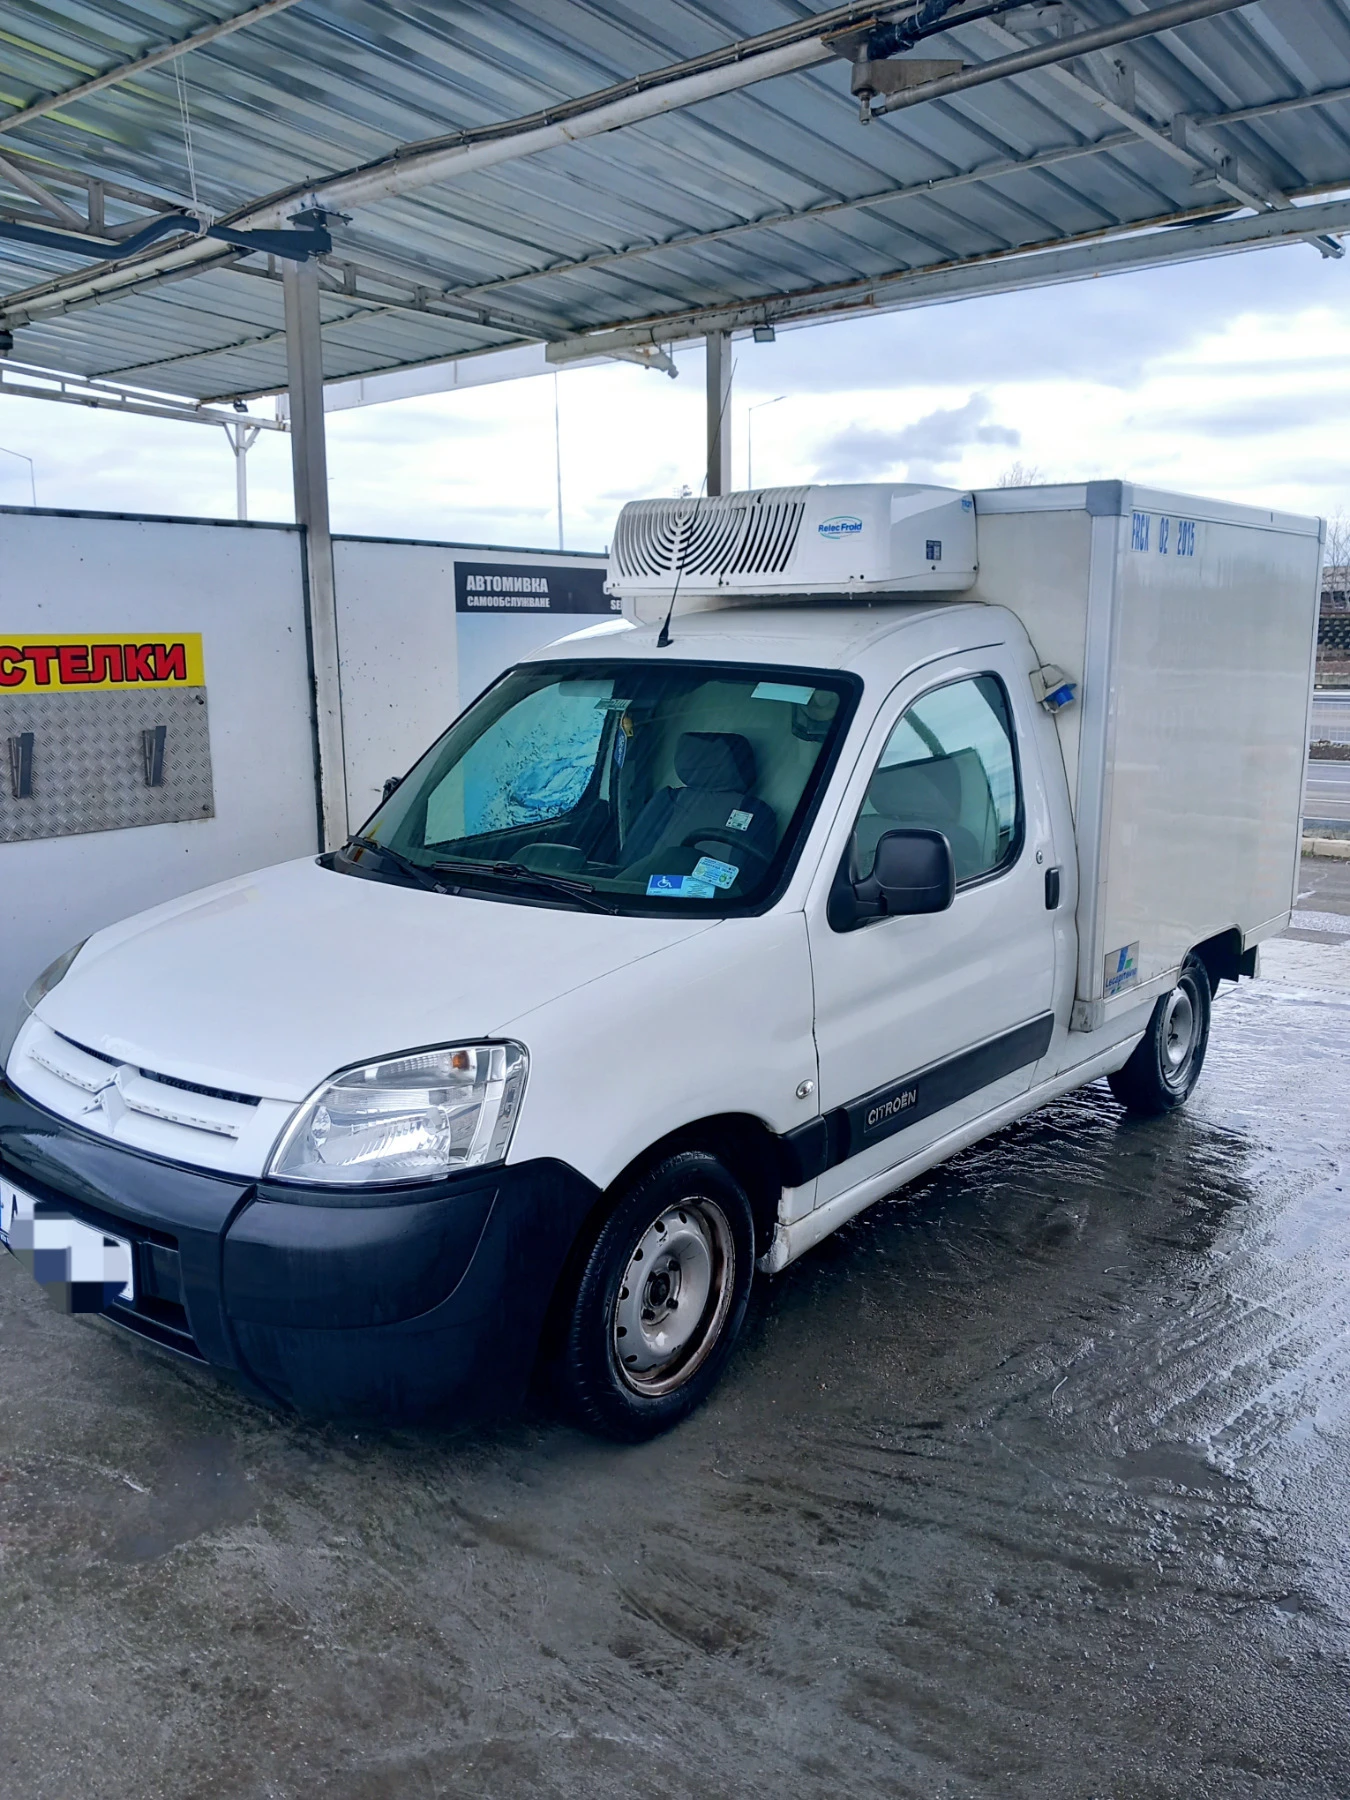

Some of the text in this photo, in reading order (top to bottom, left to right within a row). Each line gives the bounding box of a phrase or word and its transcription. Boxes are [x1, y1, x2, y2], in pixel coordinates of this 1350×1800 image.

[1132, 512, 1195, 556] FRCX 02 2015
[466, 575, 549, 593] АВТОМИВКА
[467, 595, 550, 608] САМООБСЛУЖВАНЕ
[610, 599, 622, 611] SE
[0, 643, 187, 687] СТЕЛКИ
[867, 1089, 917, 1125] CITROËN
